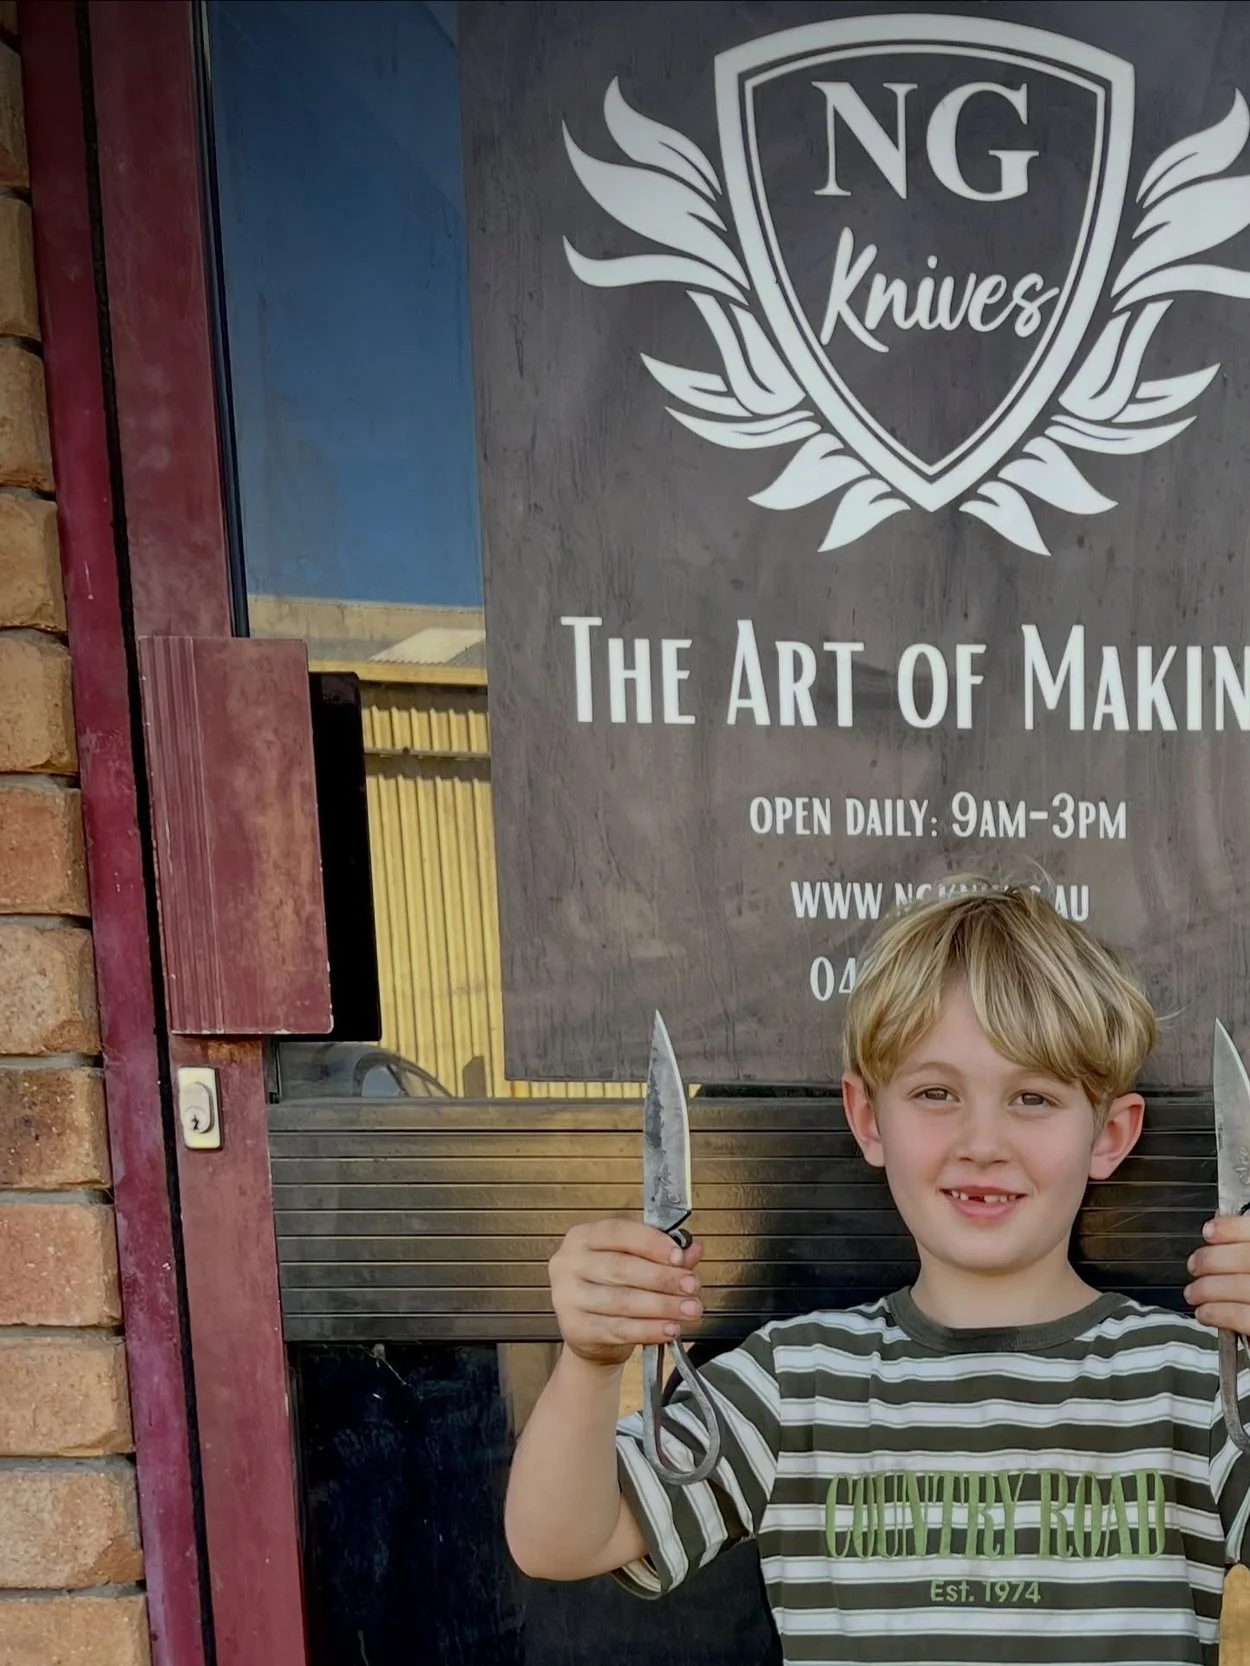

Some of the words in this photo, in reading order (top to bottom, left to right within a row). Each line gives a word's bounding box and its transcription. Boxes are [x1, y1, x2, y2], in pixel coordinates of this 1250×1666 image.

[812, 81, 1039, 201] NG
[820, 226, 1061, 353] Knives
[560, 616, 696, 725] THE
[726, 619, 865, 728] ART
[897, 643, 987, 729] OF
[749, 796, 831, 836] OPEN
[845, 797, 939, 838] DAILY:
[951, 791, 1128, 840] 9AM-3PM
[824, 1470, 1024, 1558] COUNTRY
[1038, 1469, 1165, 1559] ROAD
[930, 1580, 975, 1602] Est.
[981, 1580, 1041, 1603] 1974
